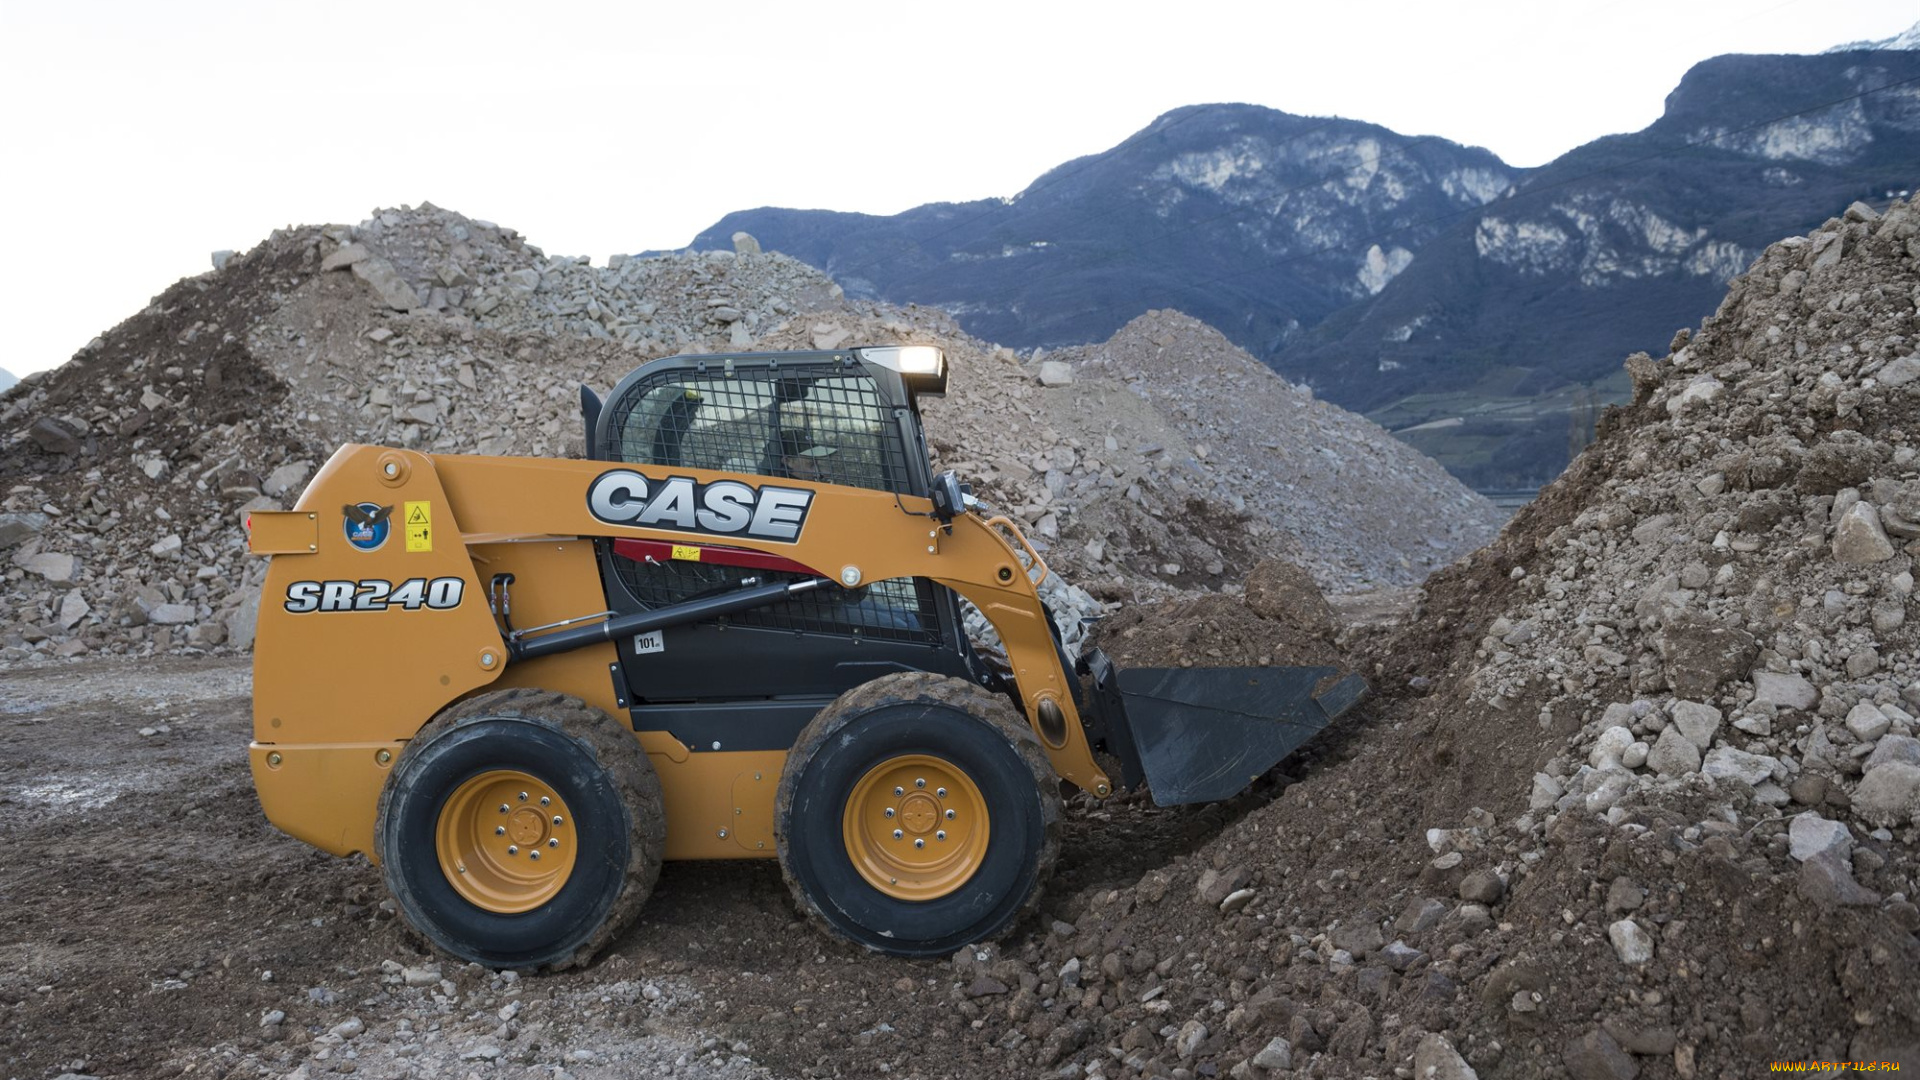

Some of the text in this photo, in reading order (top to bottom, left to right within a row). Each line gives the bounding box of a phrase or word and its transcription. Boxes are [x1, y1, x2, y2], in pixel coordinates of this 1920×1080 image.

[589, 470, 811, 539] CASE
[285, 577, 464, 612] SR240
[638, 637, 655, 649] 101
